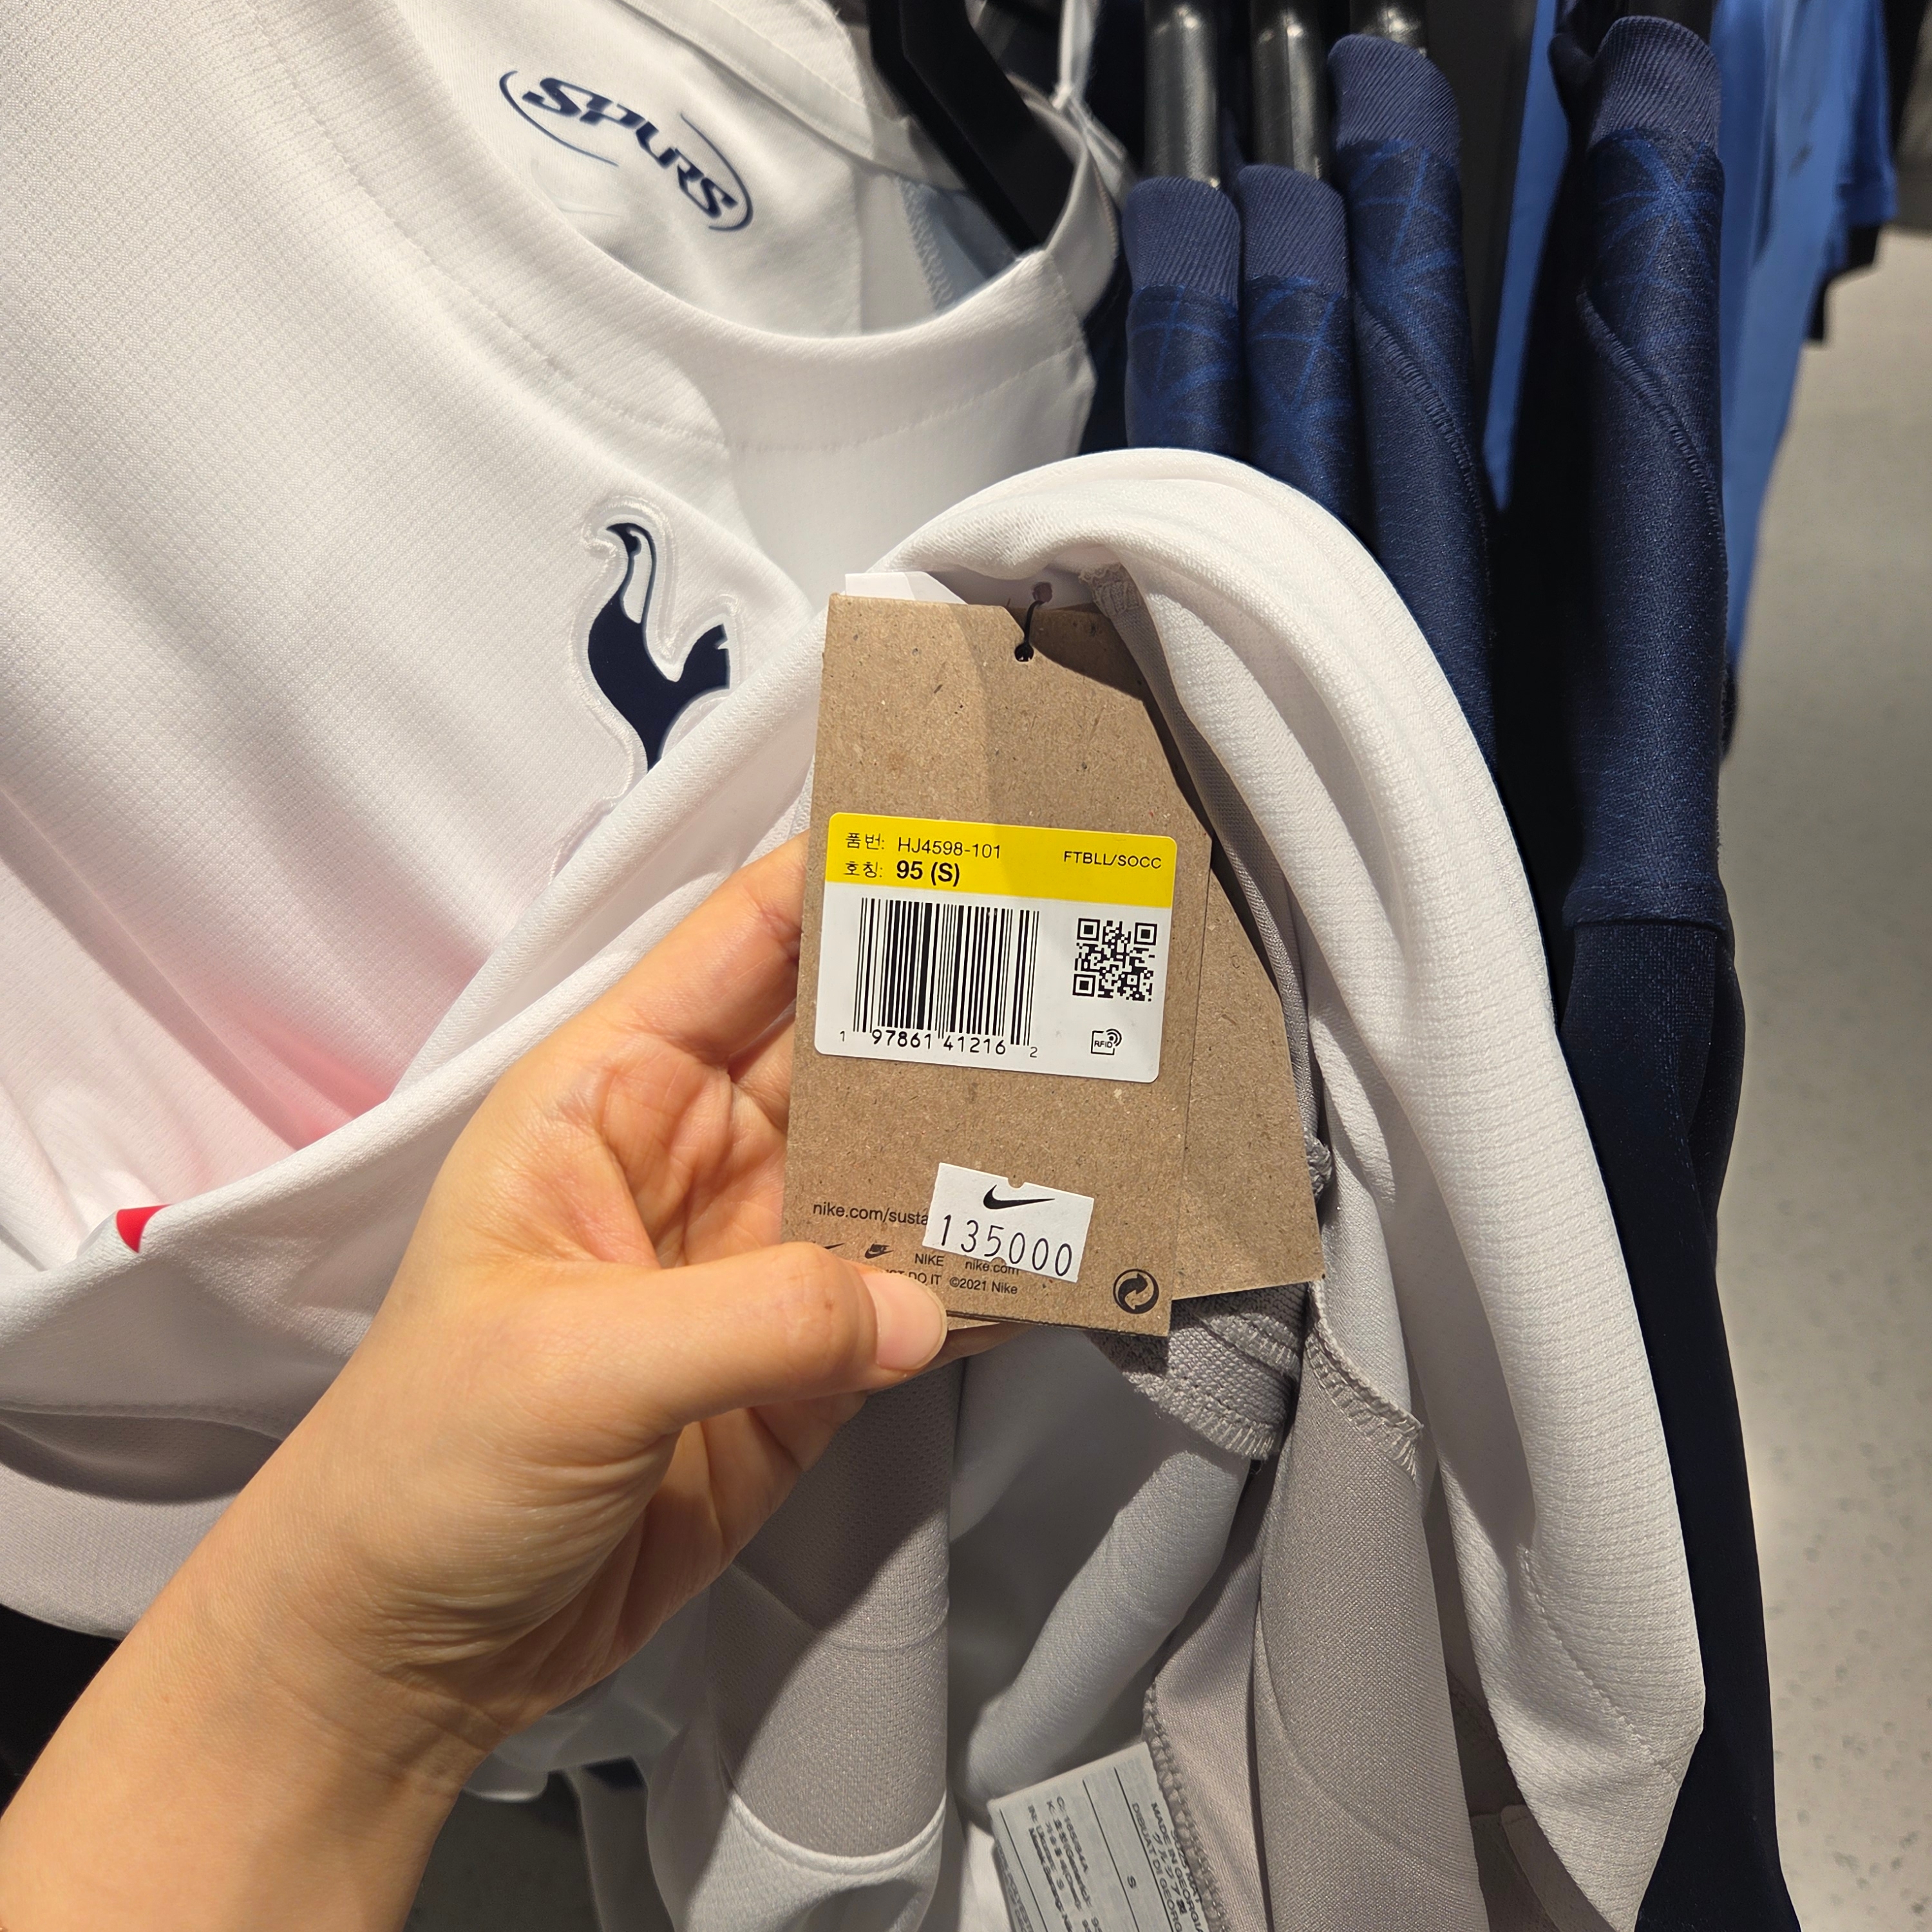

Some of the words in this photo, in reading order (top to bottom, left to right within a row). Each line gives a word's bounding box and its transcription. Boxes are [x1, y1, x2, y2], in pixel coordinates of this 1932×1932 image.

[522, 77, 738, 218] SPURS
[845, 832, 885, 851] 품번:
[898, 837, 1001, 859] HJ4598-101
[1063, 850, 1162, 870] FTBLL/SOCC
[843, 860, 884, 878] 호칭:
[896, 860, 923, 880] 95
[931, 861, 960, 887] (S)
[840, 1030, 846, 1042] 1
[871, 1029, 932, 1050] 97861
[943, 1035, 1007, 1056] 41216
[1030, 1046, 1038, 1058] 2
[1094, 1039, 1113, 1048] RFID
[940, 1214, 1074, 1277] 135000
[914, 1253, 945, 1267] NIKE
[965, 1260, 1019, 1276] nike.com
[931, 1273, 942, 1285] IT
[991, 1280, 1018, 1294] Nike
[1132, 1802, 1157, 1857] DIBUAT
[1151, 1858, 1163, 1875] DI
[1150, 1802, 1171, 1846] MADE
[1167, 1848, 1178, 1864] IN
[1125, 1874, 1138, 1889] S
